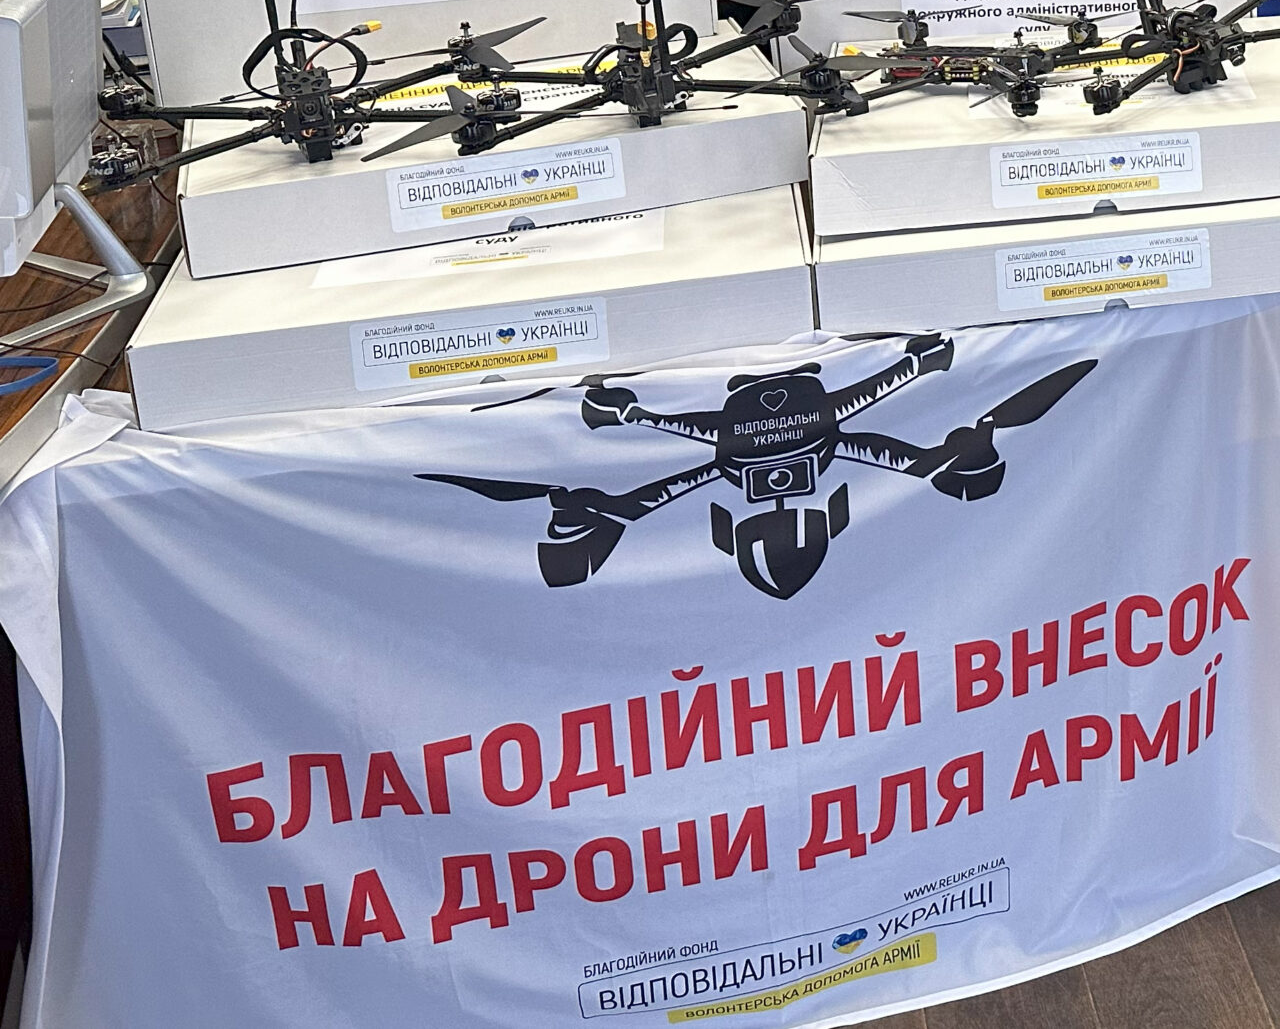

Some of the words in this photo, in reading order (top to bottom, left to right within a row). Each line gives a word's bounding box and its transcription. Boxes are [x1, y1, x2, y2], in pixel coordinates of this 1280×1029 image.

[1007, 1, 1138, 17] адміністративног
[1043, 148, 1059, 156] ФОНД
[400, 169, 444, 180] БЛАГОДІЙНИЙ
[446, 166, 464, 174] ФОНД
[1009, 159, 1105, 180] ВІДПОВІДАЛЬНІ
[1130, 152, 1185, 170] УКРАЇНЦІ
[408, 173, 517, 202] ВІДПОВІДАЛЬНІ
[544, 160, 605, 181] УКРАЇНЦІ
[1045, 184, 1095, 196] ВОЛОНТЕРСЬКА
[1097, 180, 1133, 192] ДОПОМОГА
[1135, 178, 1151, 188] АРМІЇ
[451, 202, 507, 215] ВОЛОНТЕРСЬКА
[509, 194, 549, 208] ДОПОМОГА
[551, 190, 570, 200] АРМІЇ
[475, 235, 519, 245] суду
[1049, 249, 1066, 258] ФОНД
[1014, 259, 1113, 283] ВІДПОВІДАЛЬНІ
[1138, 250, 1194, 269] УКРАЇНЦІ
[1052, 285, 1103, 297] ВОЛОНТЕРСЬКА
[1105, 280, 1141, 292] ДОПОМОГА
[1143, 277, 1160, 288] АРМІЇ
[534, 304, 593, 318] WWW.REUKR.IN.UA
[364, 324, 412, 337] БЛАГОДІЙНИЙ
[414, 322, 435, 332] ФОНД
[373, 332, 491, 359] ВІДПОВІДАЛЬНІ
[521, 320, 588, 342] УКРАЇНЦІ
[419, 360, 480, 375] ВОЛОНТЕРСЬКА
[483, 354, 525, 368] ДОПОМОГА
[527, 350, 548, 363] АРМІЇ
[734, 411, 820, 434] ВІДПОВІДАЛЬНІ
[753, 429, 803, 447] УКРАЇНЦІ
[206, 631, 924, 843] БЛАГОДІЙНИЙ
[954, 556, 1252, 711] ВНЕСОК
[267, 868, 401, 950] НА
[430, 806, 771, 944] ДРОНИ
[798, 750, 985, 870] ДЛЯ
[1008, 652, 1224, 799] АРМІЇ
[903, 857, 1005, 901] WWW.REUKR.IN.UA
[599, 942, 823, 1012] ВІДПОВІДАЛЬНІ
[878, 880, 994, 942] УКРАЇНЦІ
[583, 947, 676, 978] БЛАГОДІЙНИЙ
[680, 940, 719, 959] ФОНД
[686, 988, 799, 1019] ВОЛОНТЕРСЬКА
[803, 957, 879, 994] ДОПОМОГА
[882, 942, 921, 969] АРМІЇ
